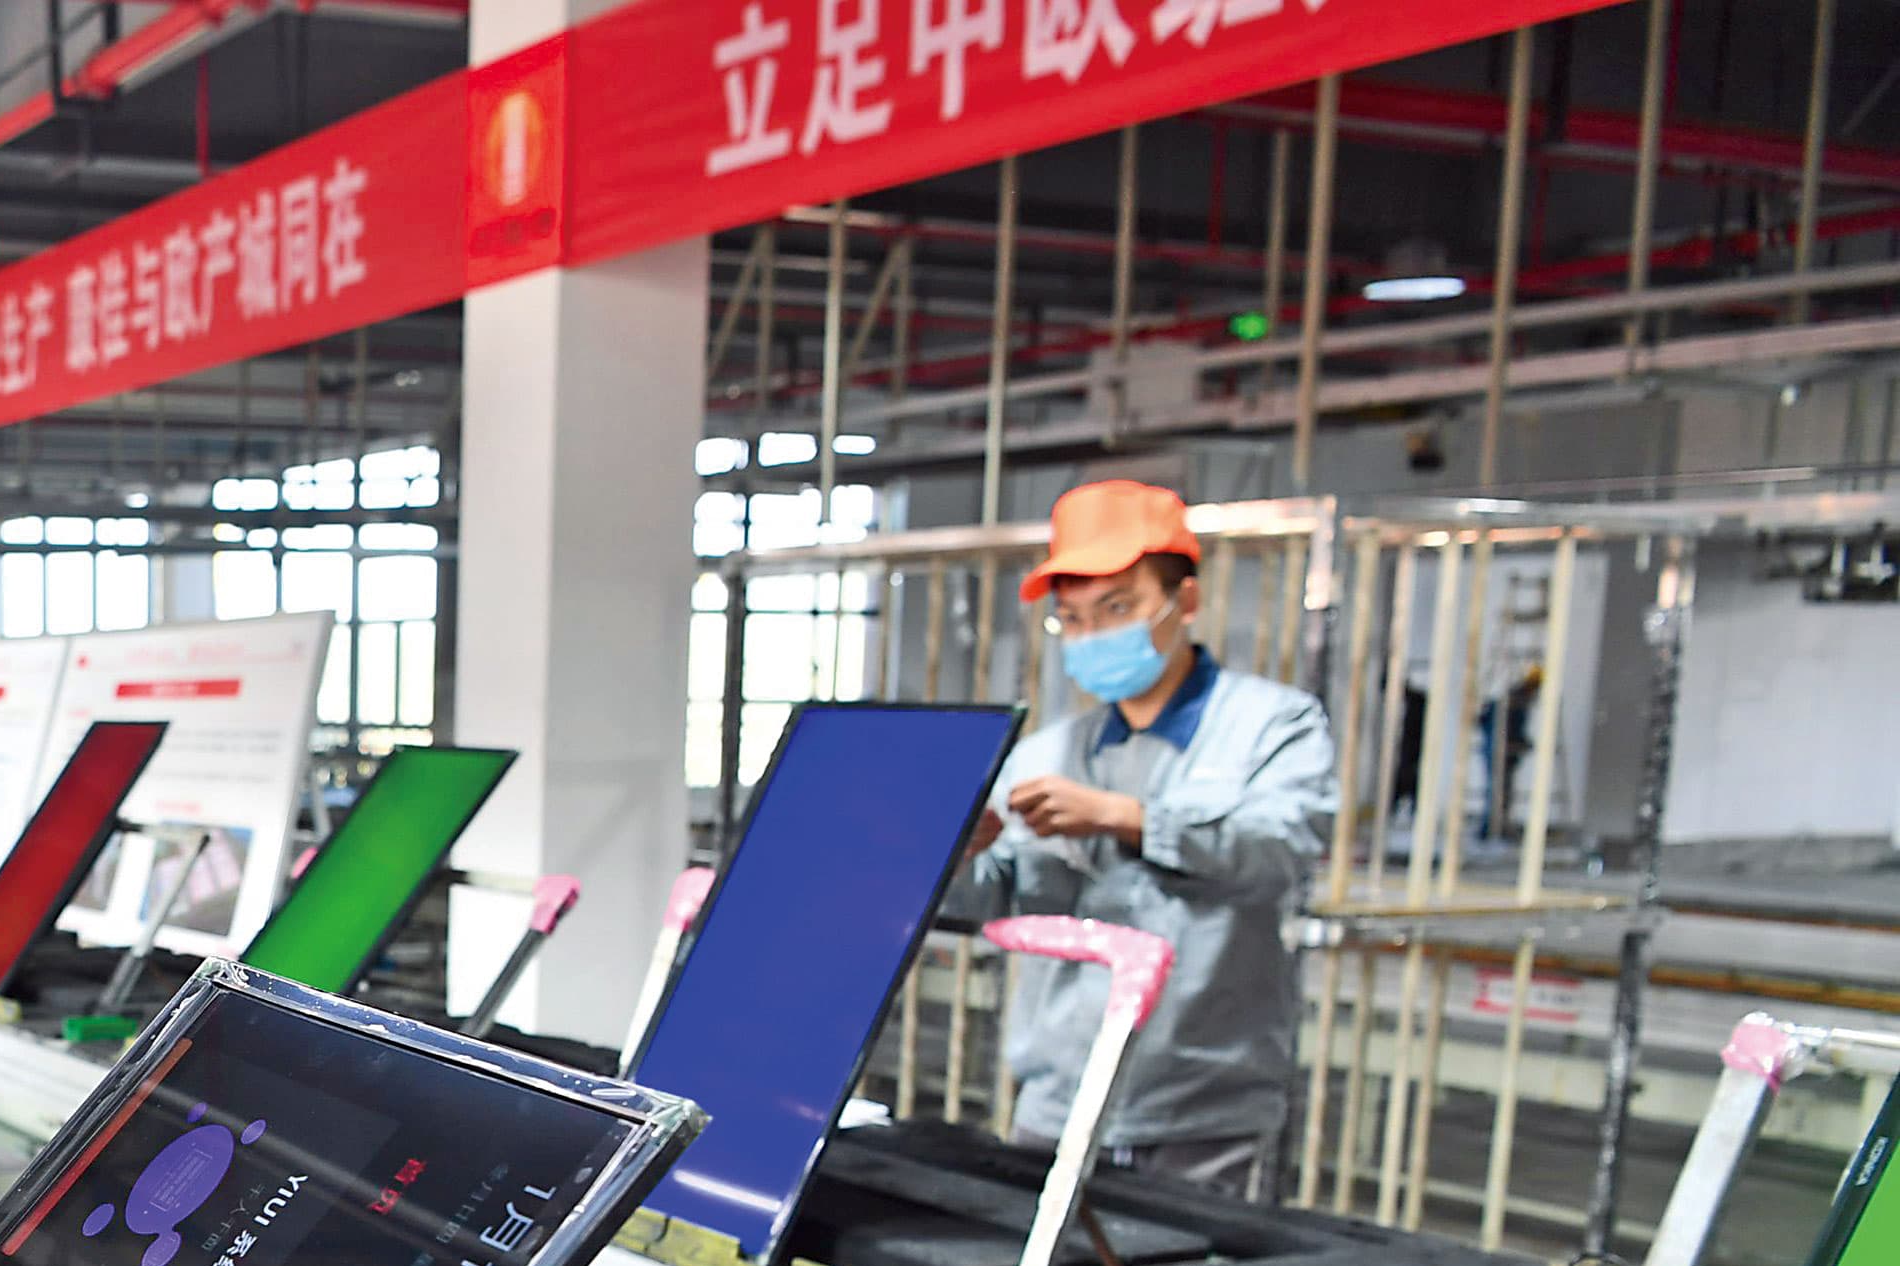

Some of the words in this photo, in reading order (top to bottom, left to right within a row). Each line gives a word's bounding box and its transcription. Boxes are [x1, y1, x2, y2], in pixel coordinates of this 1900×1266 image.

[706, 0, 1328, 177] 立足中欧
[254, 1175, 308, 1226] YIUI
